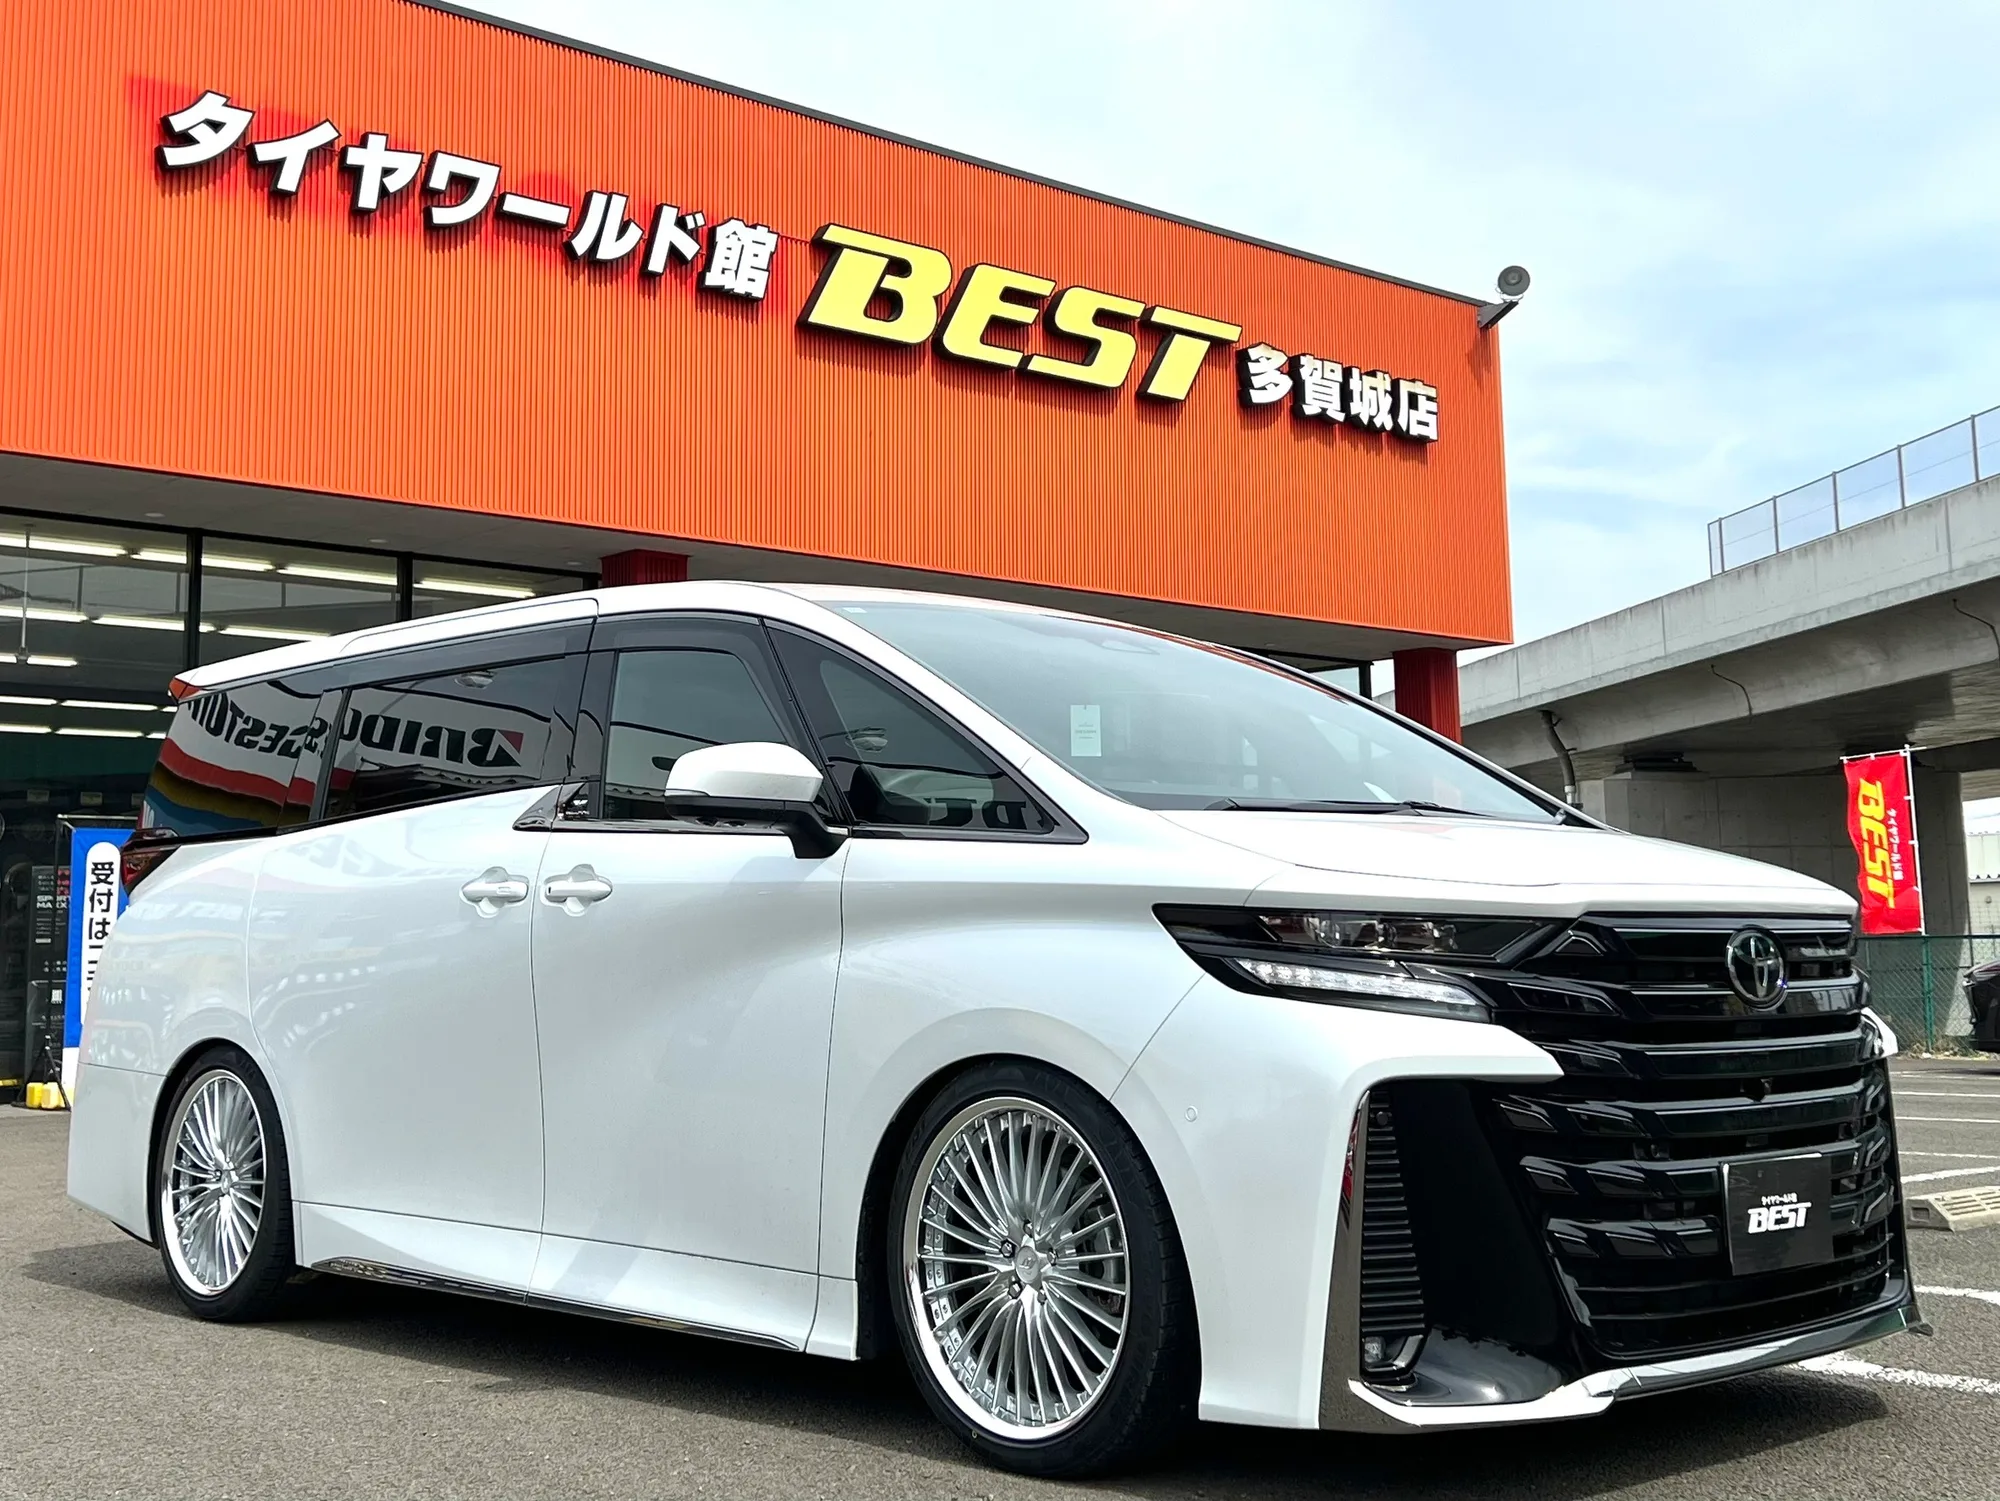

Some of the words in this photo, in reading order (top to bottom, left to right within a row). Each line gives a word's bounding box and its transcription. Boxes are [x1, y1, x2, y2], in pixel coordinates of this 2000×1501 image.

[161, 90, 779, 300] タイヤワールド館
[803, 223, 1243, 402] BEST
[1241, 342, 1438, 442] 多賀城店
[1858, 778, 1895, 909] BEST
[86, 861, 115, 991] 受付は
[1747, 1201, 1812, 1234] BEST
